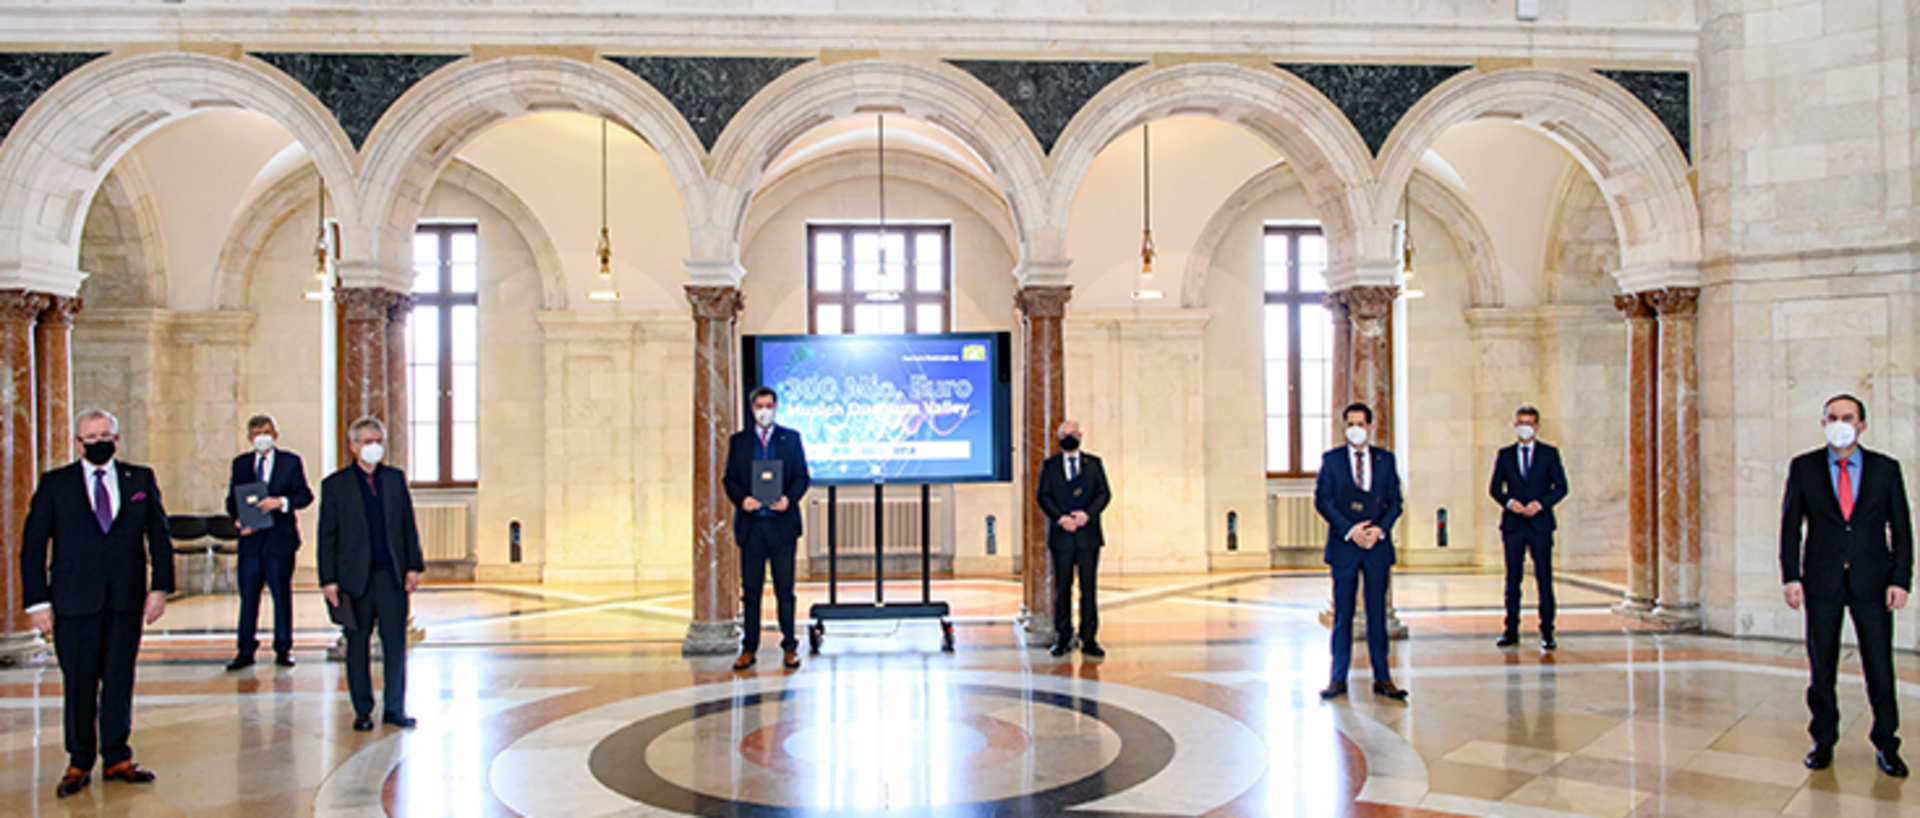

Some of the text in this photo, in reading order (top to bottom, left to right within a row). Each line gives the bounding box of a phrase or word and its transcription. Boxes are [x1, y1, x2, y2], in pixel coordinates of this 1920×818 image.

[784, 376, 837, 400] 300
[909, 374, 973, 399] Euro
[786, 402, 844, 416] Munich
[923, 401, 970, 418] Valley
